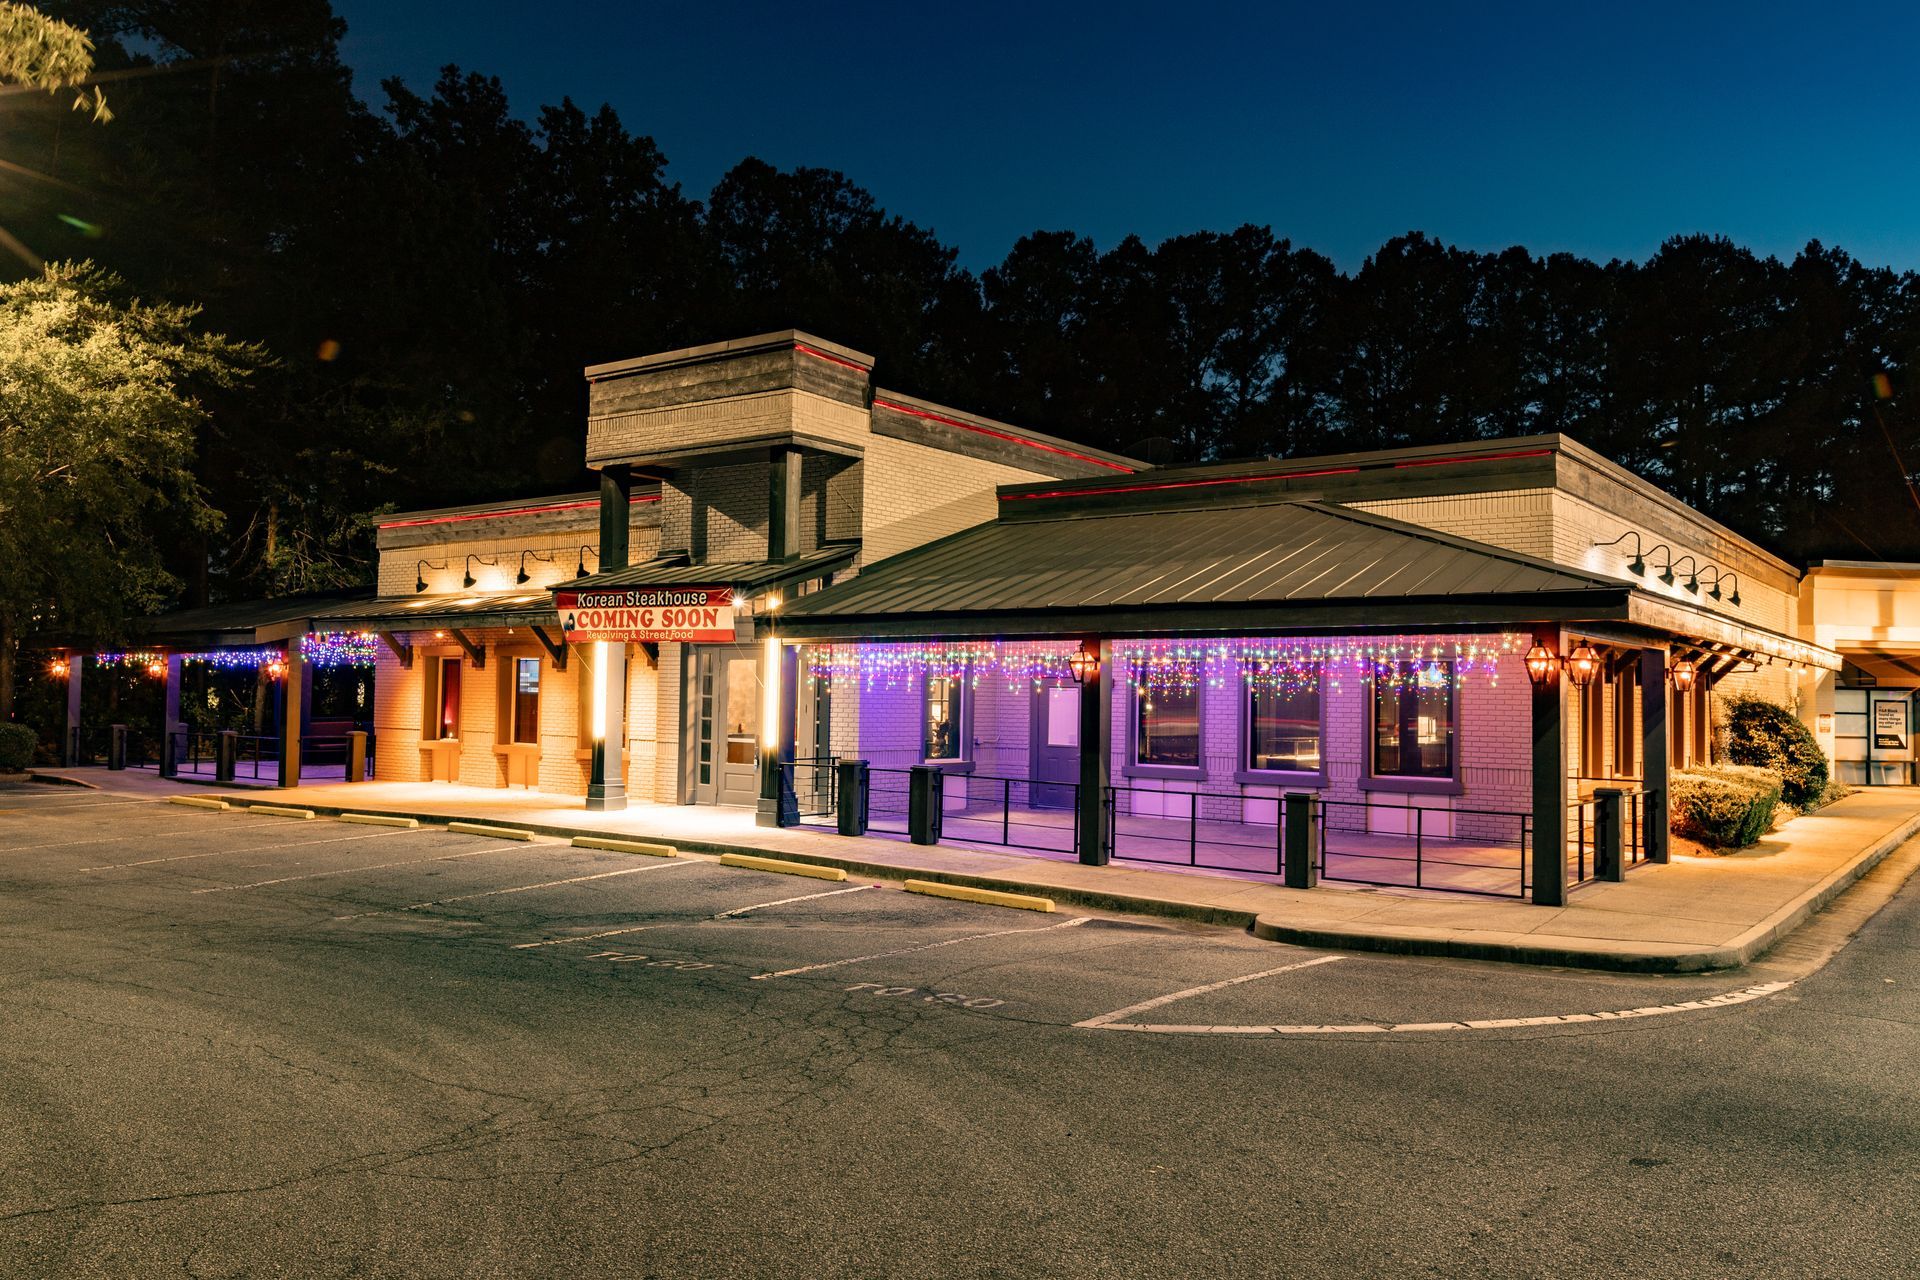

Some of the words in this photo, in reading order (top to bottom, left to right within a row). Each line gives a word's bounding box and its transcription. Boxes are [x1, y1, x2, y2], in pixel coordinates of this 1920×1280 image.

[577, 592, 623, 608] Korean
[626, 590, 707, 607] Steakhouse
[576, 609, 654, 629] COMING
[661, 608, 718, 628] SOON
[586, 630, 629, 641] Revolving
[639, 630, 668, 638] Street
[668, 629, 694, 639] Food
[843, 982, 917, 996] TO
